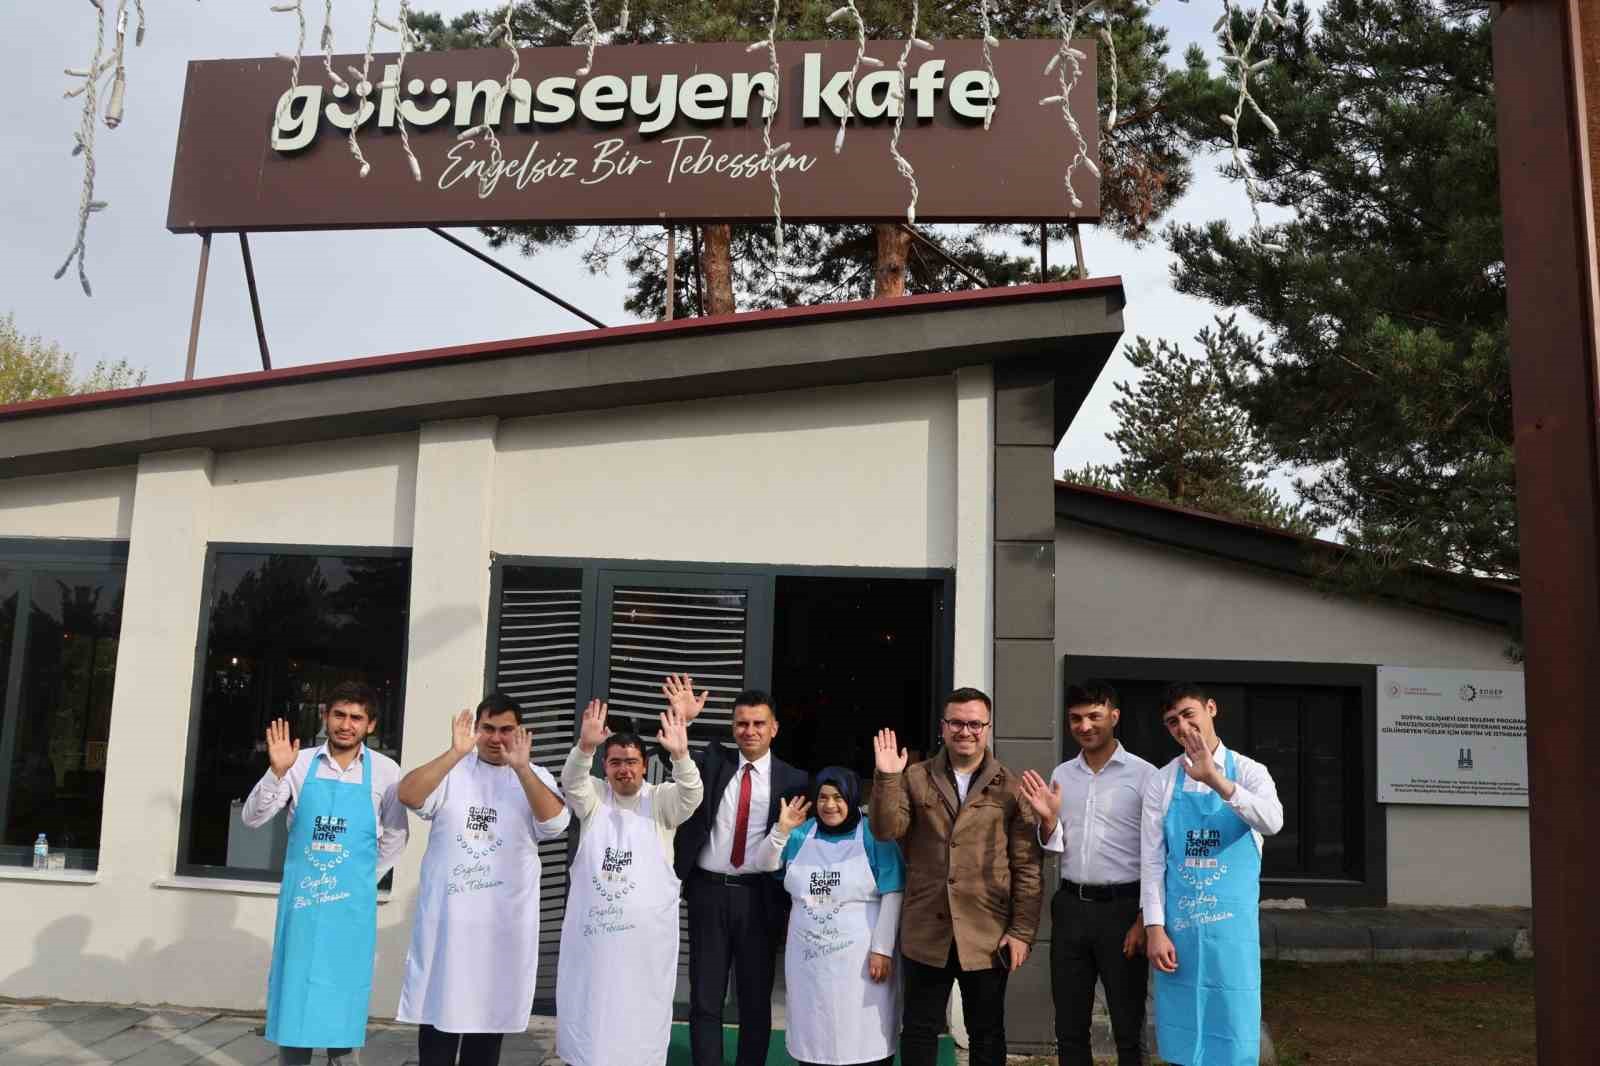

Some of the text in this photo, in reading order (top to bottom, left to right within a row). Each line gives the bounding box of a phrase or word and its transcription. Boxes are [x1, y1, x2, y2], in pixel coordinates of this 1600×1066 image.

[271, 51, 1000, 152] gülümseyen kafe
[437, 139, 577, 199] Engelsiz
[580, 138, 653, 186] Bir
[466, 817, 489, 832] kafe
[471, 814, 498, 824] seyen
[312, 828, 337, 842] kafe
[317, 824, 347, 834] seyen
[1185, 845, 1210, 857] kafe
[810, 883, 831, 896] kafe
[812, 879, 841, 888] seyen
